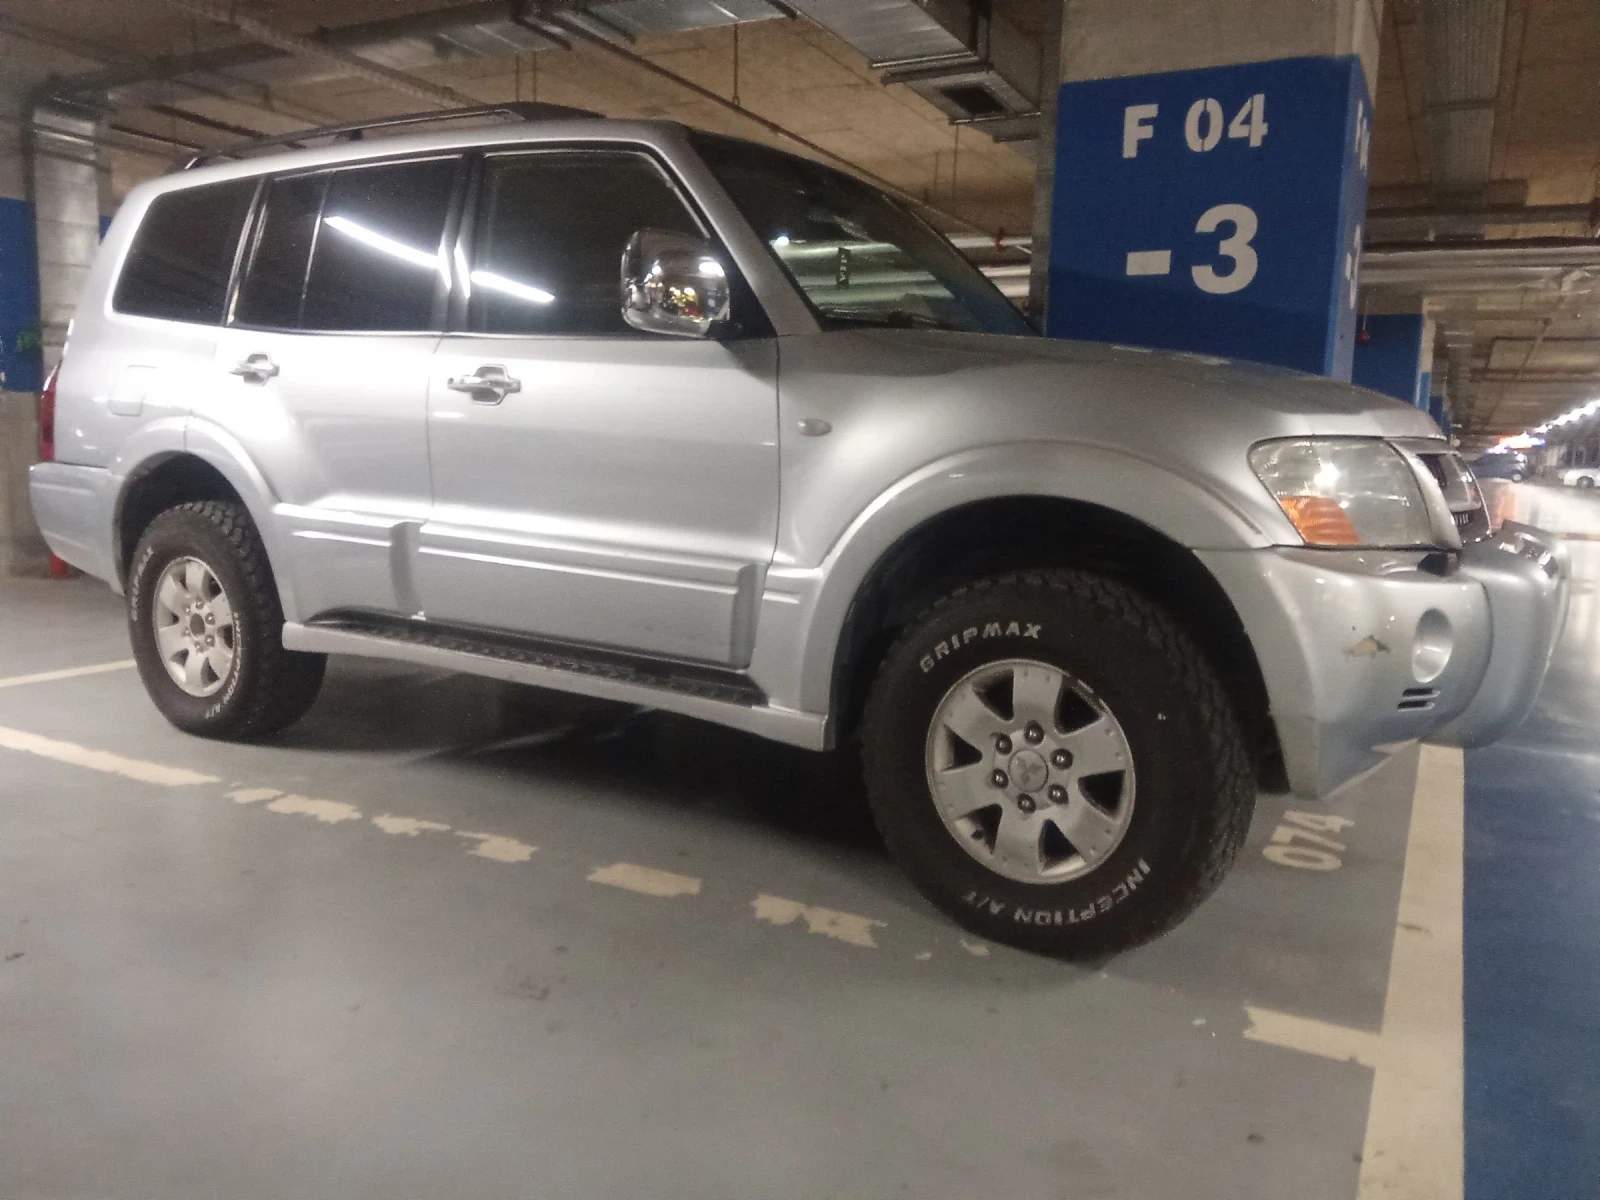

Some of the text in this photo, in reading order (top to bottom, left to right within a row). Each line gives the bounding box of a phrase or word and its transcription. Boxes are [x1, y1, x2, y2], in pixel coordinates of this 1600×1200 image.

[1123, 93, 1269, 158] F 04
[919, 620, 1042, 673] GRIPMAX
[1013, 858, 1150, 926] INCEPTION
